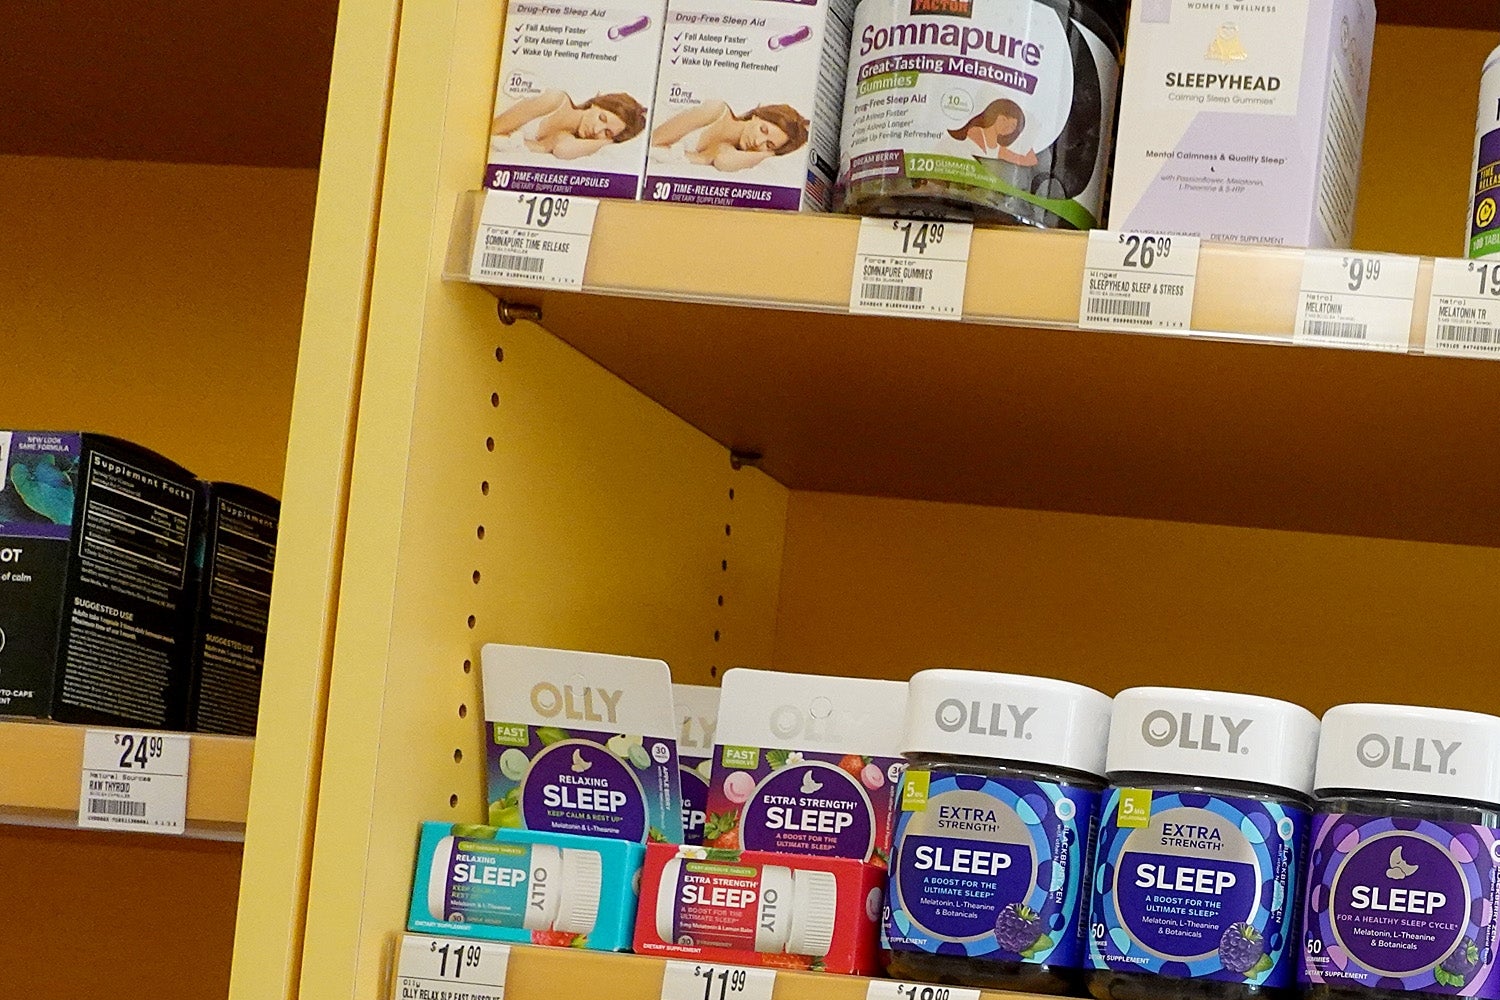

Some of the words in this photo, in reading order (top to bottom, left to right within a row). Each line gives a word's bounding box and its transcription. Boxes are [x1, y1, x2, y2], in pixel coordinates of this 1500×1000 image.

[860, 21, 1041, 66] Somnapure
[861, 53, 944, 81] Great-Tasting
[949, 60, 1028, 89] Melatonin
[1165, 71, 1281, 92] SLEEPYHEAD
[859, 74, 913, 94] Gummies
[492, 171, 510, 188] 30
[570, 176, 609, 188] CAPSULES
[1089, 278, 1129, 292] SLEEPYHEAD
[1131, 281, 1151, 293] SLEEP
[1159, 284, 1183, 296] STRESS
[94, 456, 159, 489] Supplement
[162, 481, 191, 500] Facts
[74, 597, 117, 617] SUGGESTED
[119, 610, 134, 621] USE
[530, 681, 623, 723] OLLY
[559, 774, 608, 787] RELAXING
[543, 785, 627, 812] SLEEP
[765, 807, 853, 834] SLEEP
[939, 806, 997, 823] EXTRA
[456, 853, 496, 864] RELAXING
[914, 846, 1012, 876] SLEEP
[453, 864, 526, 887] SLEEP
[684, 875, 711, 885] EXTRA
[530, 867, 547, 910] OLLY
[681, 886, 756, 908] SLEEP
[1350, 886, 1447, 914] SLEEP
